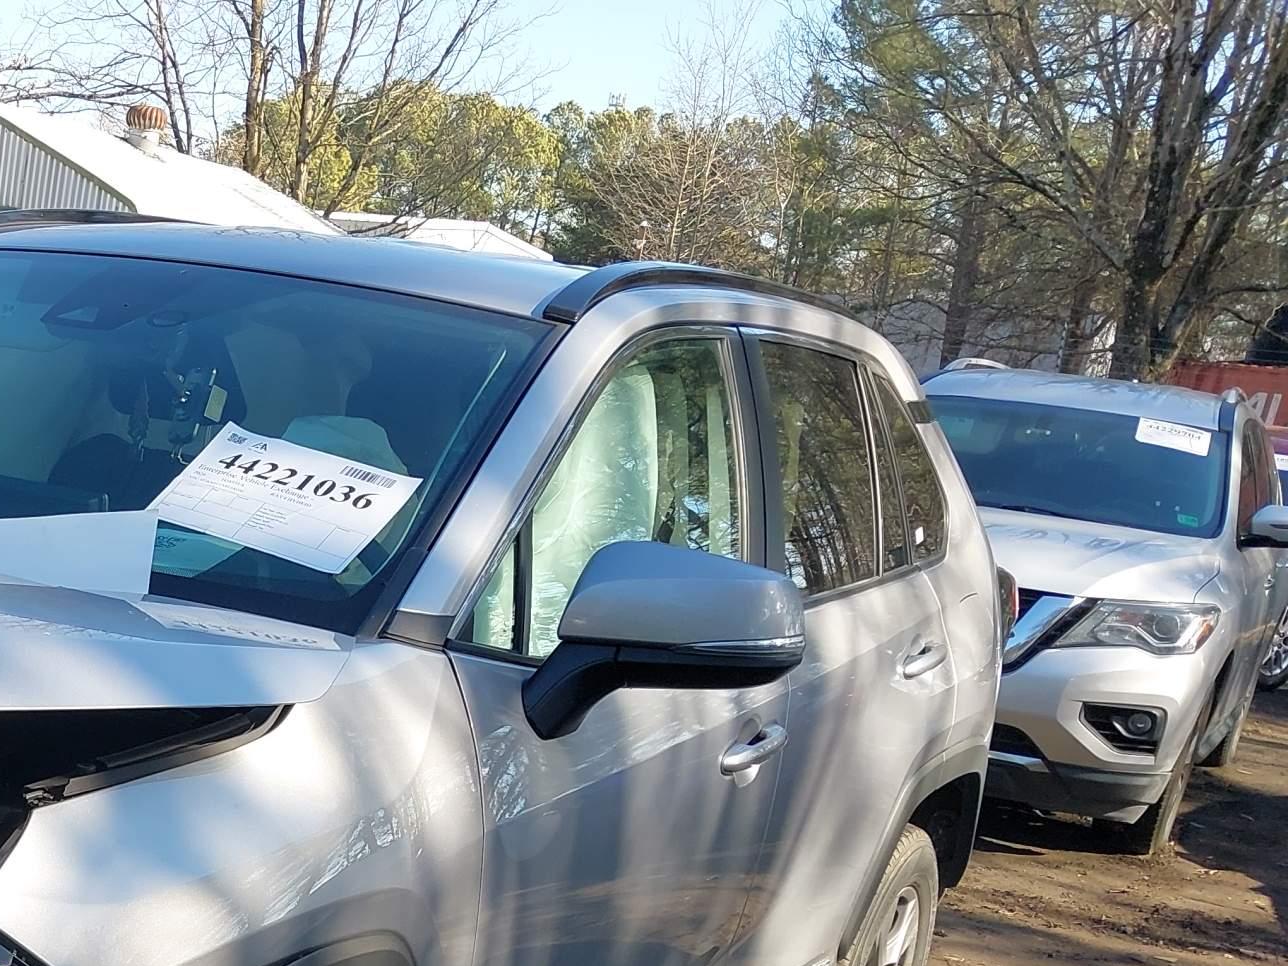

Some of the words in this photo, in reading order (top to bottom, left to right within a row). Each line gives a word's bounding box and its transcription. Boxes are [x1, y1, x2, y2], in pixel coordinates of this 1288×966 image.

[197, 463, 238, 479] Enterprise
[239, 474, 269, 488] Vehicle
[269, 483, 309, 501] Exchange
[218, 453, 380, 509] 44221036
